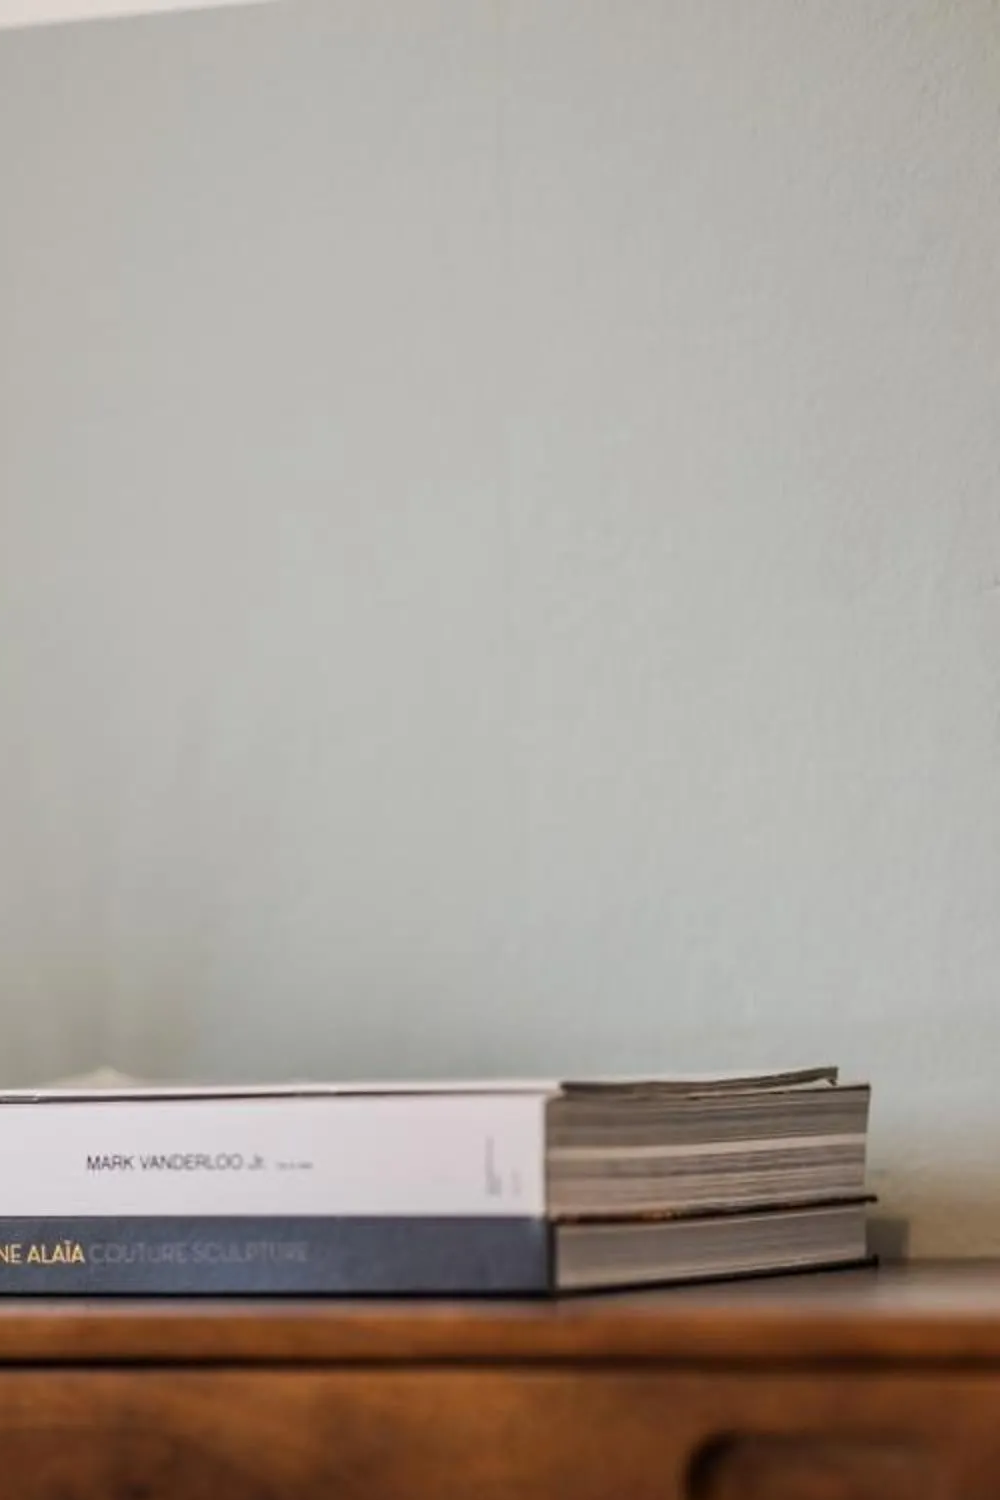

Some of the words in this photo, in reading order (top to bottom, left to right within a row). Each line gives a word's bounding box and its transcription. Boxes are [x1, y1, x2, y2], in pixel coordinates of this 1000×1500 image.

[87, 1154, 135, 1171] MARK
[139, 1153, 243, 1171] VANDERLOO
[27, 1239, 85, 1264] ALAÏA
[89, 1242, 188, 1264] COUTURE
